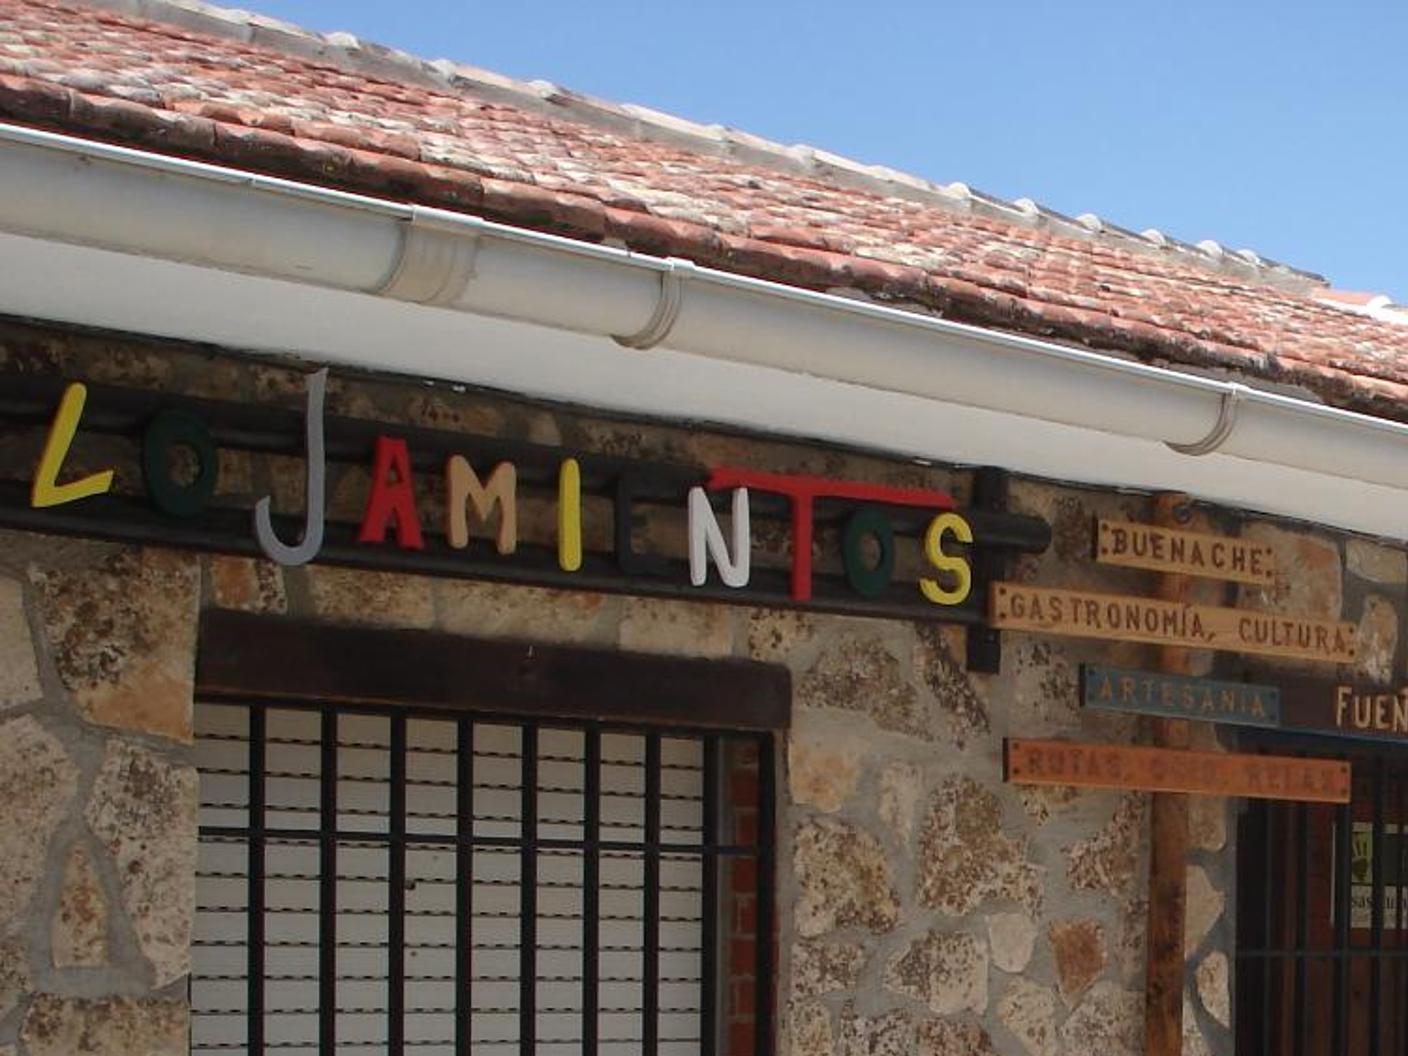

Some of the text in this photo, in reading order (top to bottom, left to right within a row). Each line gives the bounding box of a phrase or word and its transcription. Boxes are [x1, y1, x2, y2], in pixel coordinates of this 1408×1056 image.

[1111, 528, 1264, 575] BUENACHE
[1010, 593, 1346, 655] GASTRONOMÍA, CULTURA
